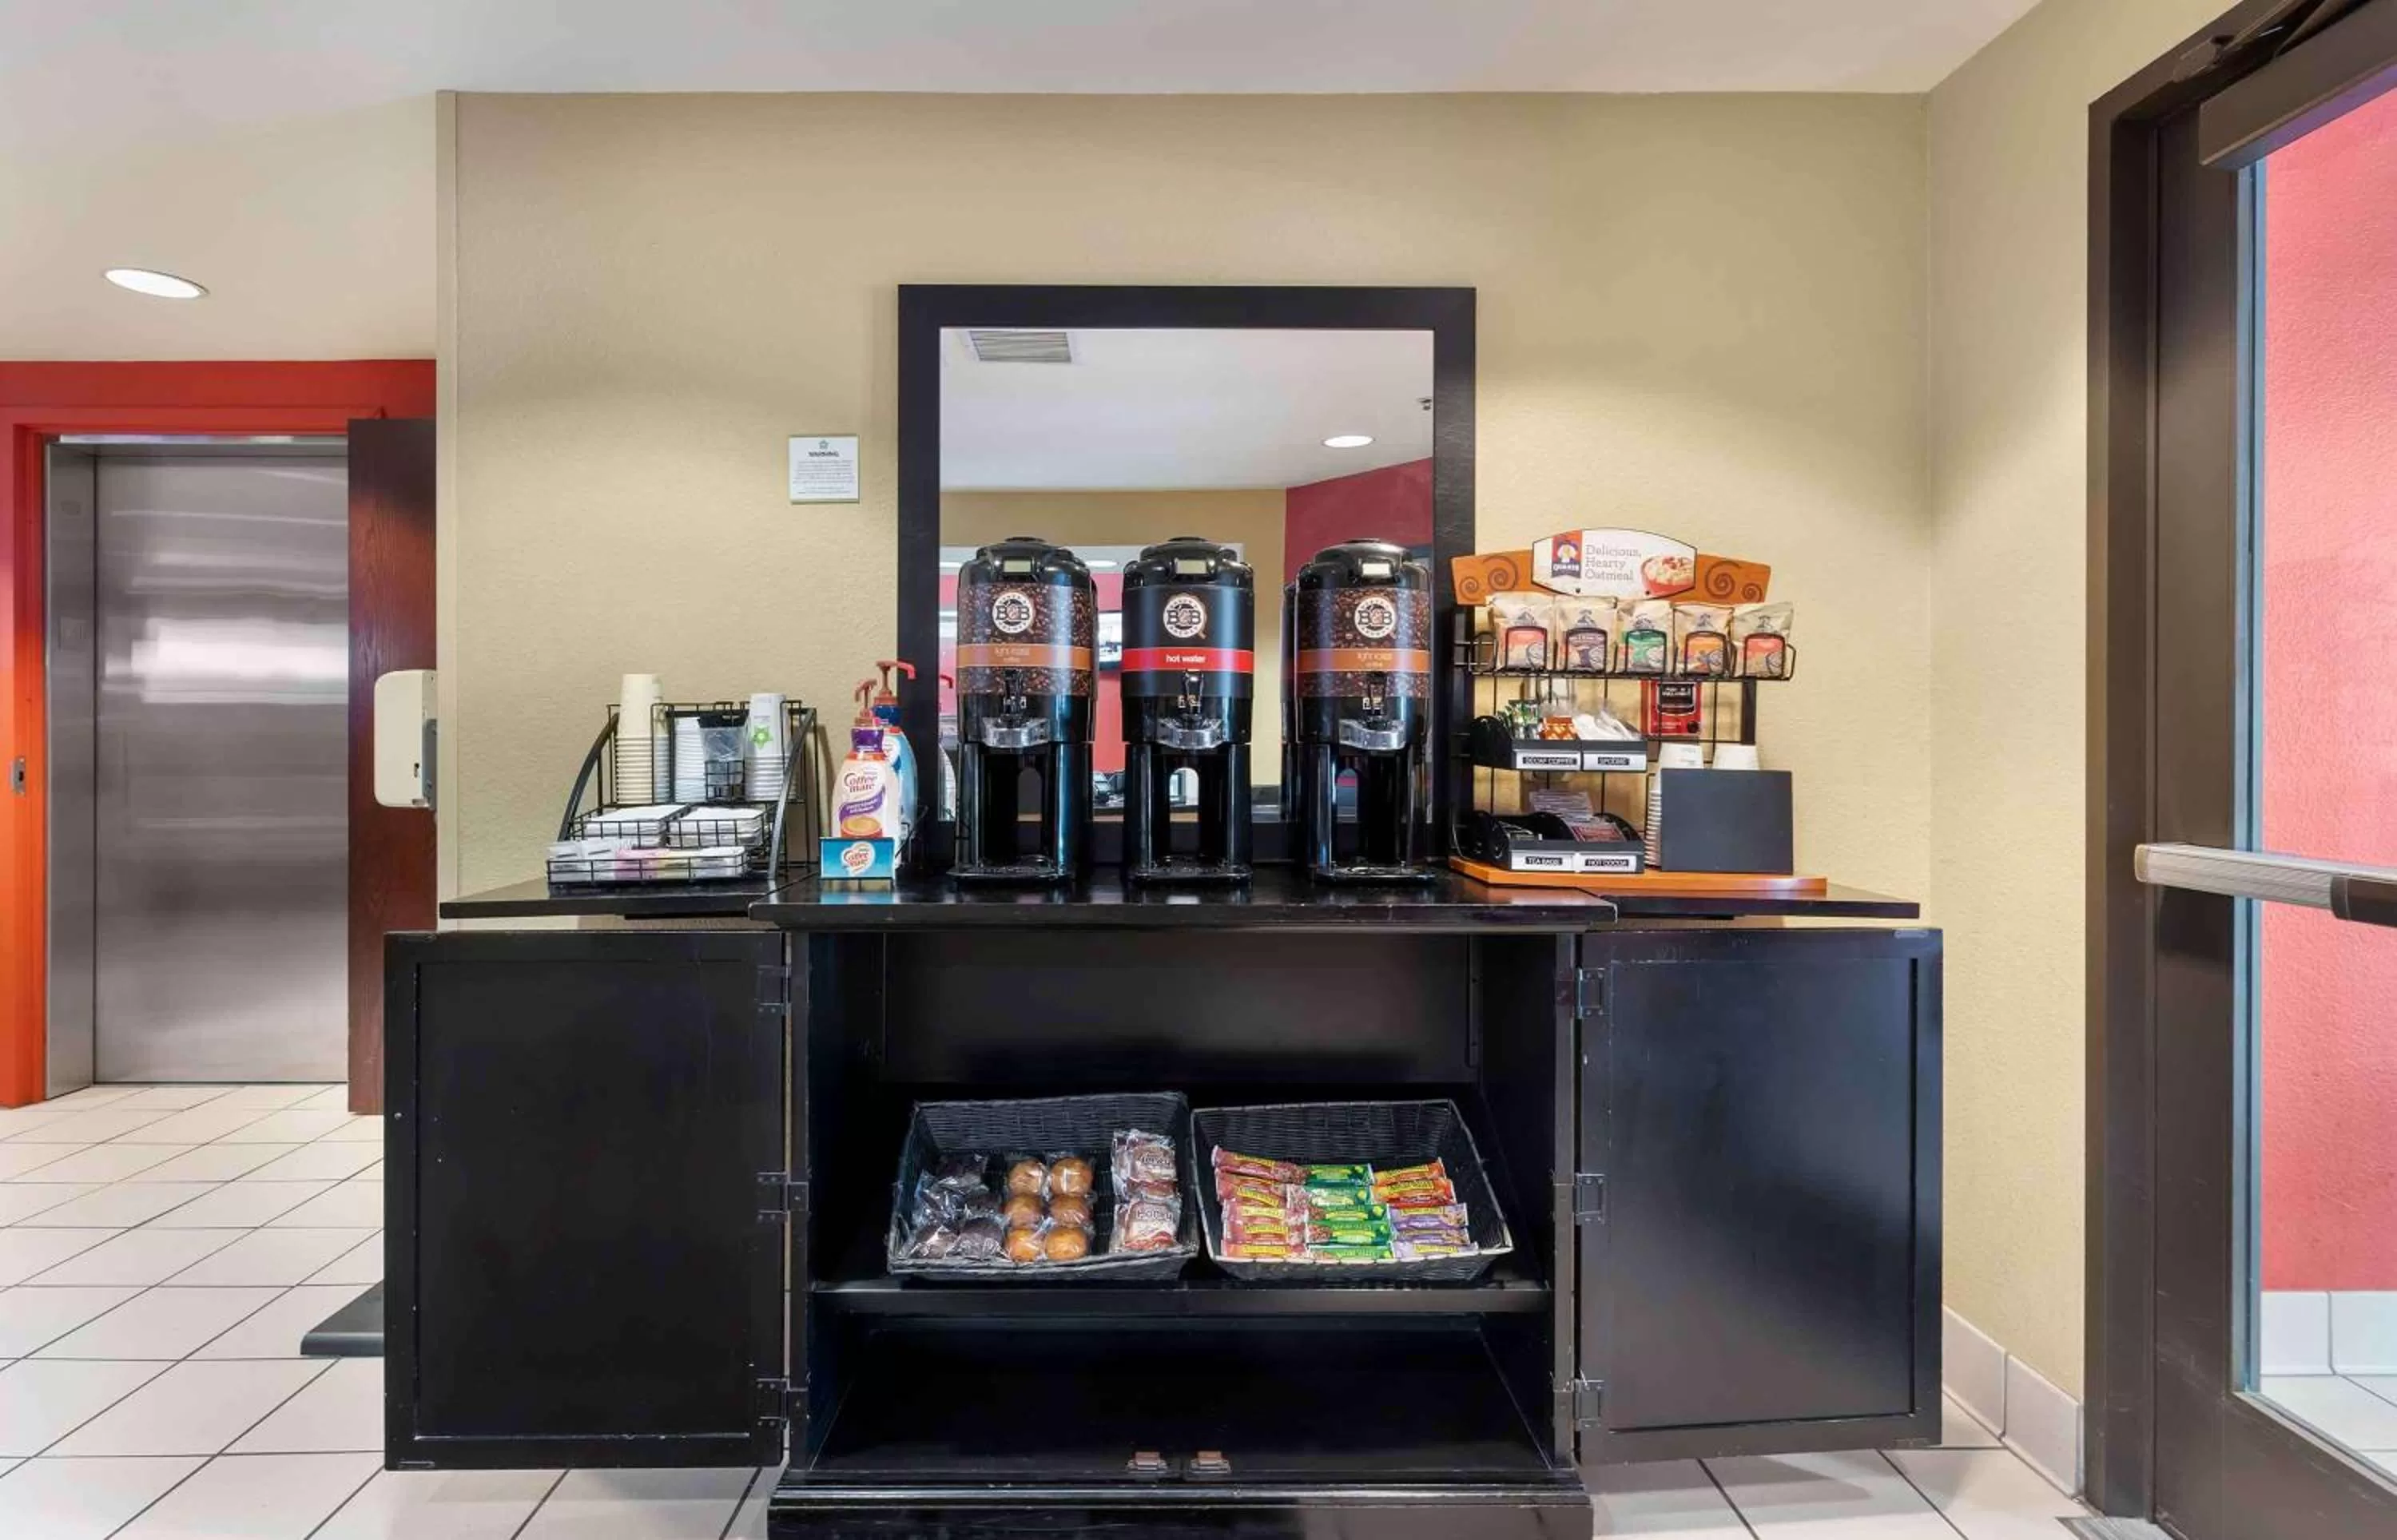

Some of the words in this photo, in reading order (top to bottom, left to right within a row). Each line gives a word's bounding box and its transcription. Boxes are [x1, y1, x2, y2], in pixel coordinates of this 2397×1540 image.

[1585, 544, 1641, 558] Delicious,
[1585, 557, 1626, 570] Hearty
[1585, 568, 1634, 581] Oatmeal
[1166, 654, 1180, 663] hot
[1182, 654, 1206, 663] water
[844, 772, 878, 788] Coffee
